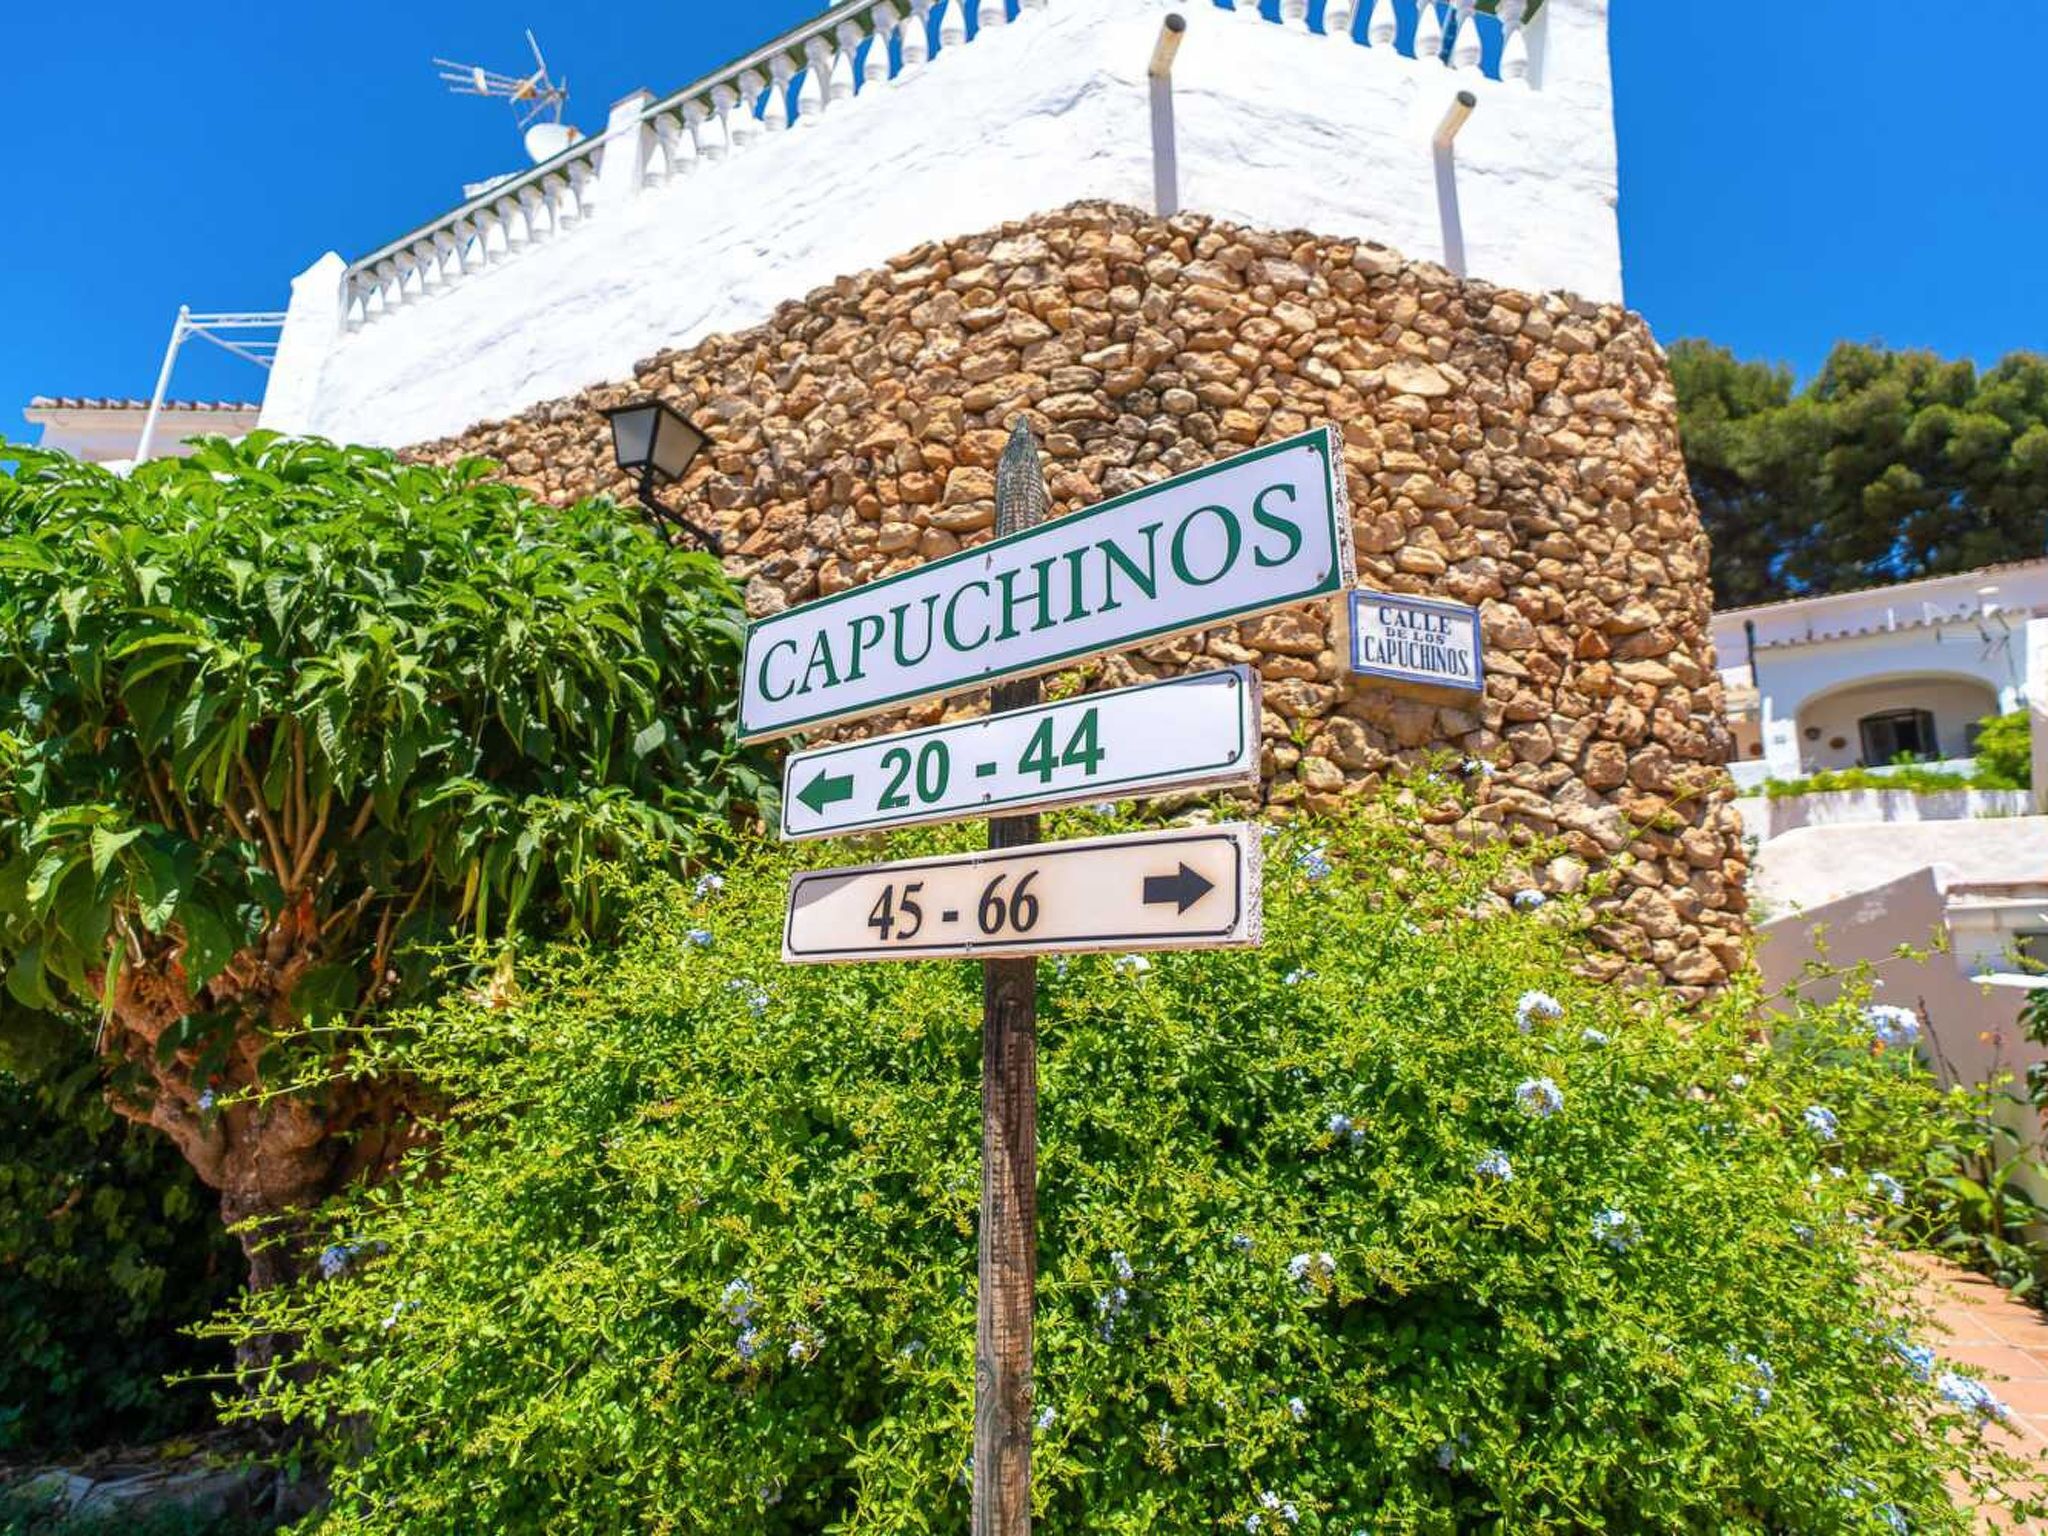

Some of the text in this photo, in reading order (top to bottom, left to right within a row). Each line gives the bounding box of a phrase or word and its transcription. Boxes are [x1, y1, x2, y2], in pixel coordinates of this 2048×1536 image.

[758, 483, 1301, 702] CAPUCHINOS
[1379, 606, 1451, 635] CALLE
[1364, 635, 1469, 677] CAPUCHINOS
[1385, 626, 1445, 645] DE LOS
[876, 707, 1105, 811] 20 - 44
[867, 870, 1040, 941] 45 - 66
